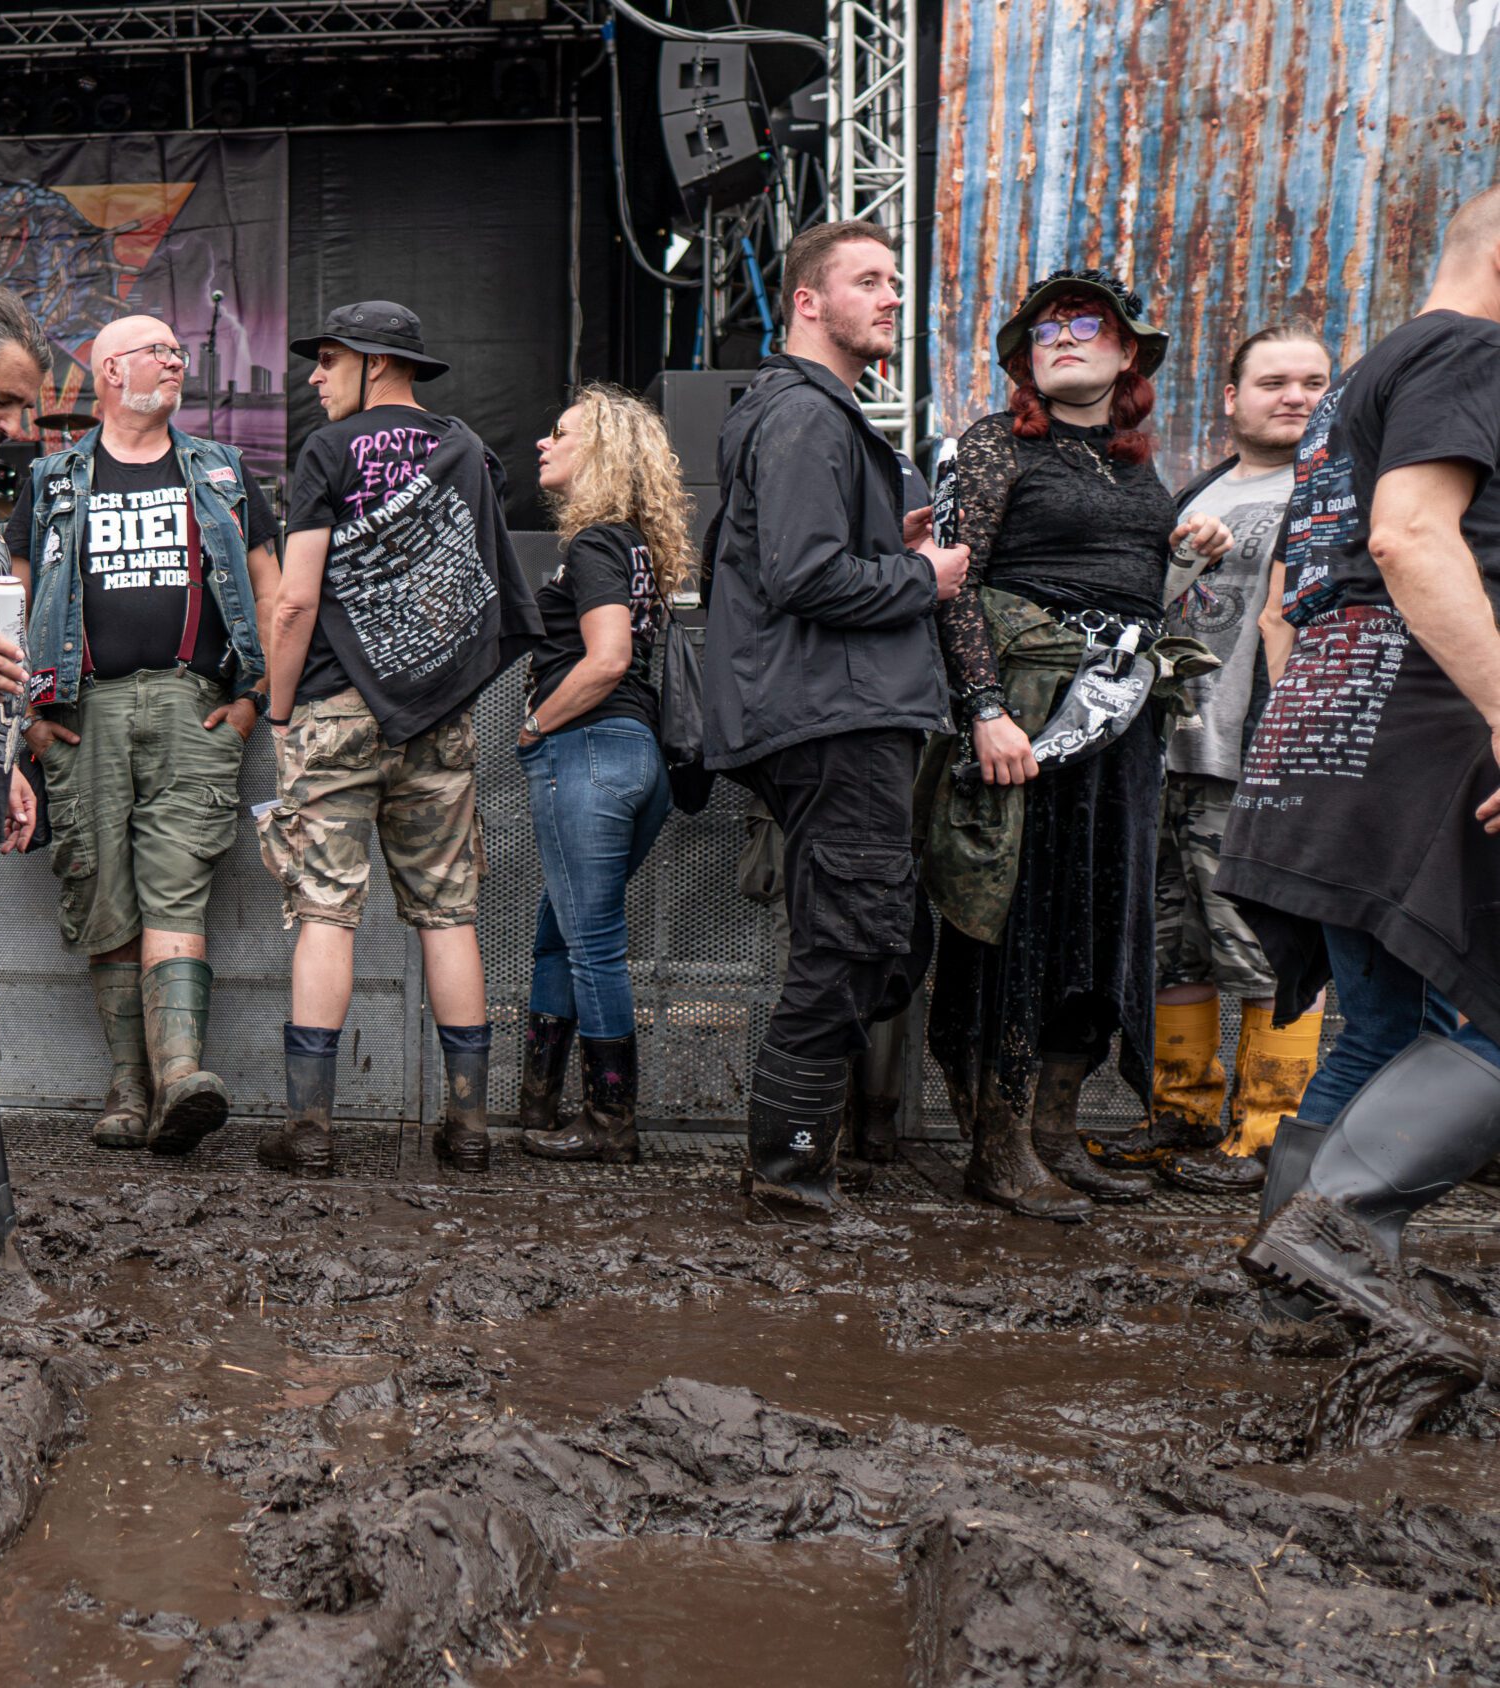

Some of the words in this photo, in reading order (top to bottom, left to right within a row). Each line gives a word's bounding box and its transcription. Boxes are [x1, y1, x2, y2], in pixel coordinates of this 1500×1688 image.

[88, 493, 124, 511] ICH
[333, 516, 376, 547] IRON
[370, 474, 432, 525] MAIDEN
[90, 555, 126, 574] ALS
[129, 550, 181, 570] WÄRE
[104, 570, 152, 590] MEIN
[154, 569, 189, 587] JOB
[1080, 685, 1132, 713] WACKEN
